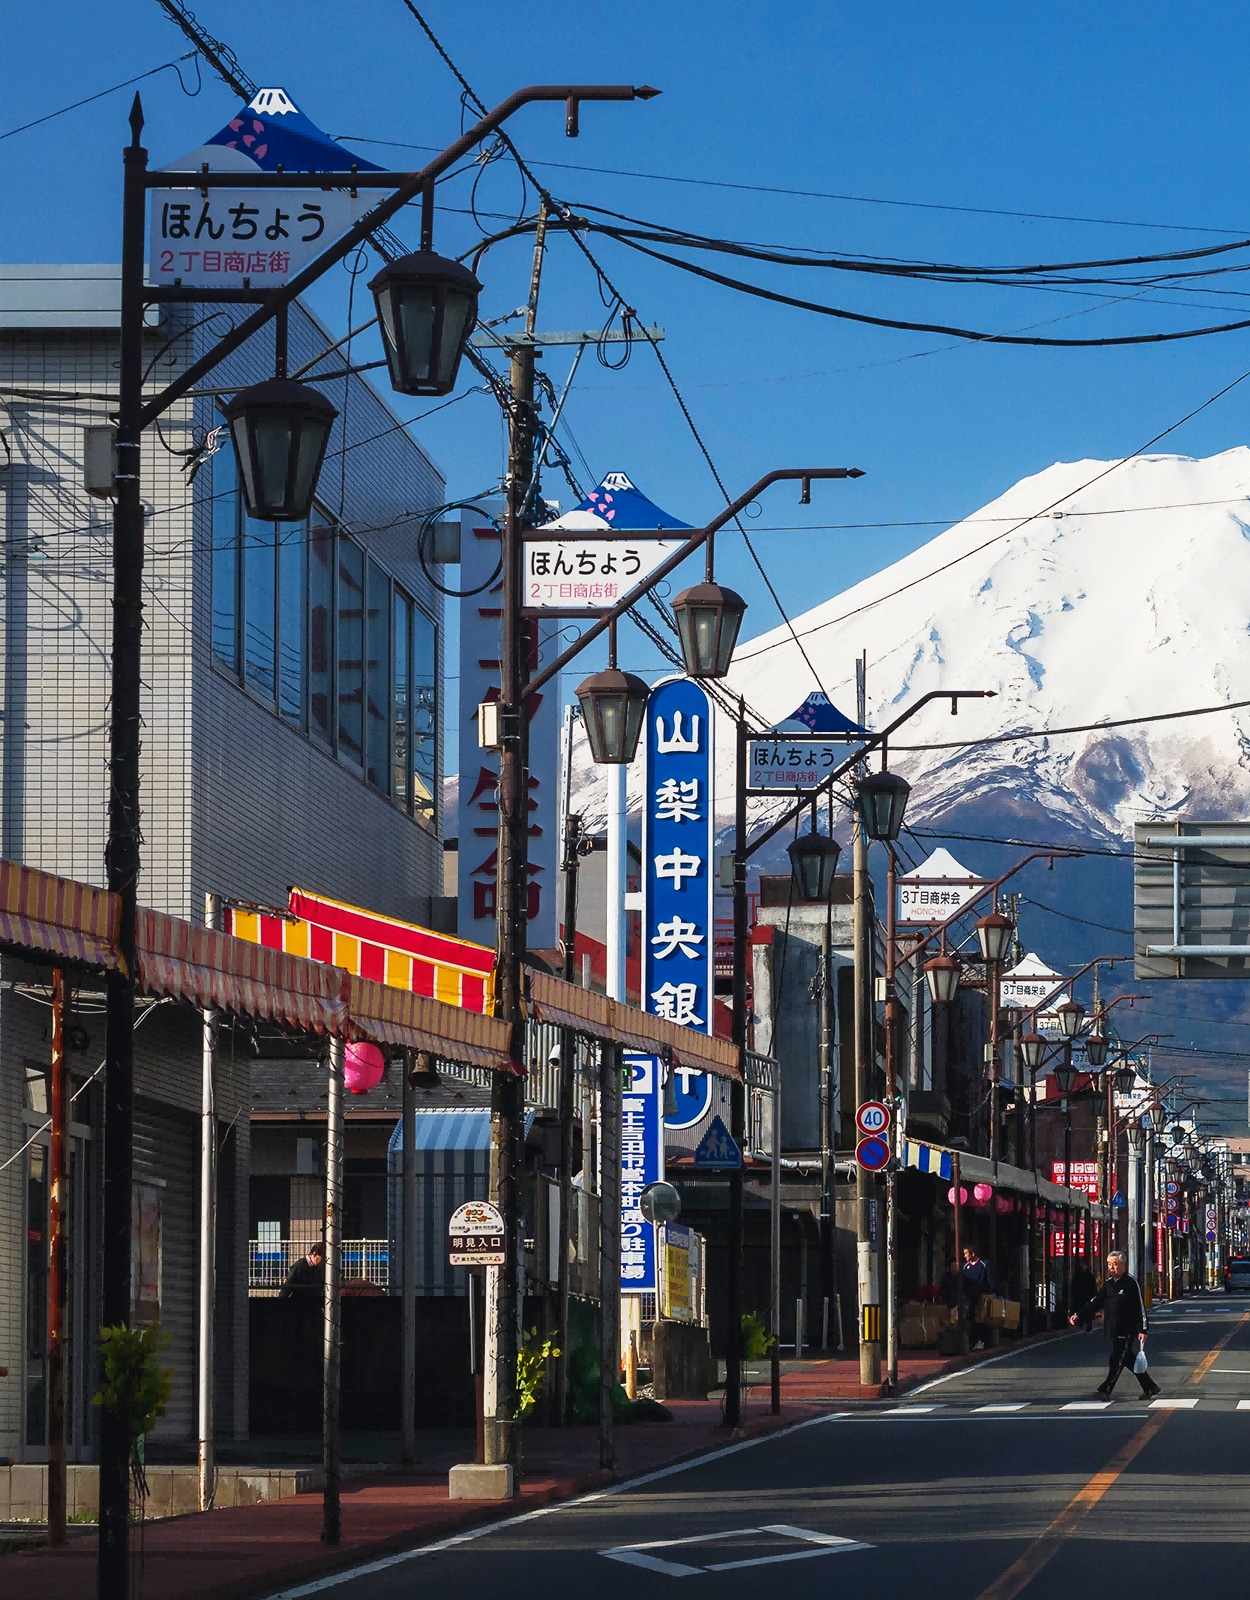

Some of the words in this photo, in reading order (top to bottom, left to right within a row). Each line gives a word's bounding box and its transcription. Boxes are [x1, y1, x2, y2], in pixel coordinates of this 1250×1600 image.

[162, 202, 325, 242] ほんちょう
[160, 249, 290, 274] 2丁目商店街
[531, 549, 641, 576] ほんちょう
[530, 583, 618, 598] 2丁目商店街
[754, 747, 835, 767] ほんちょう
[754, 770, 819, 782] 2丁目商店街
[901, 890, 961, 905] 3丁目商栄会
[911, 907, 946, 916] HONCHO
[1003, 984, 1047, 996] 3丁目商栄会
[864, 1111, 883, 1126] 40
[452, 1237, 501, 1248] 明見入口
